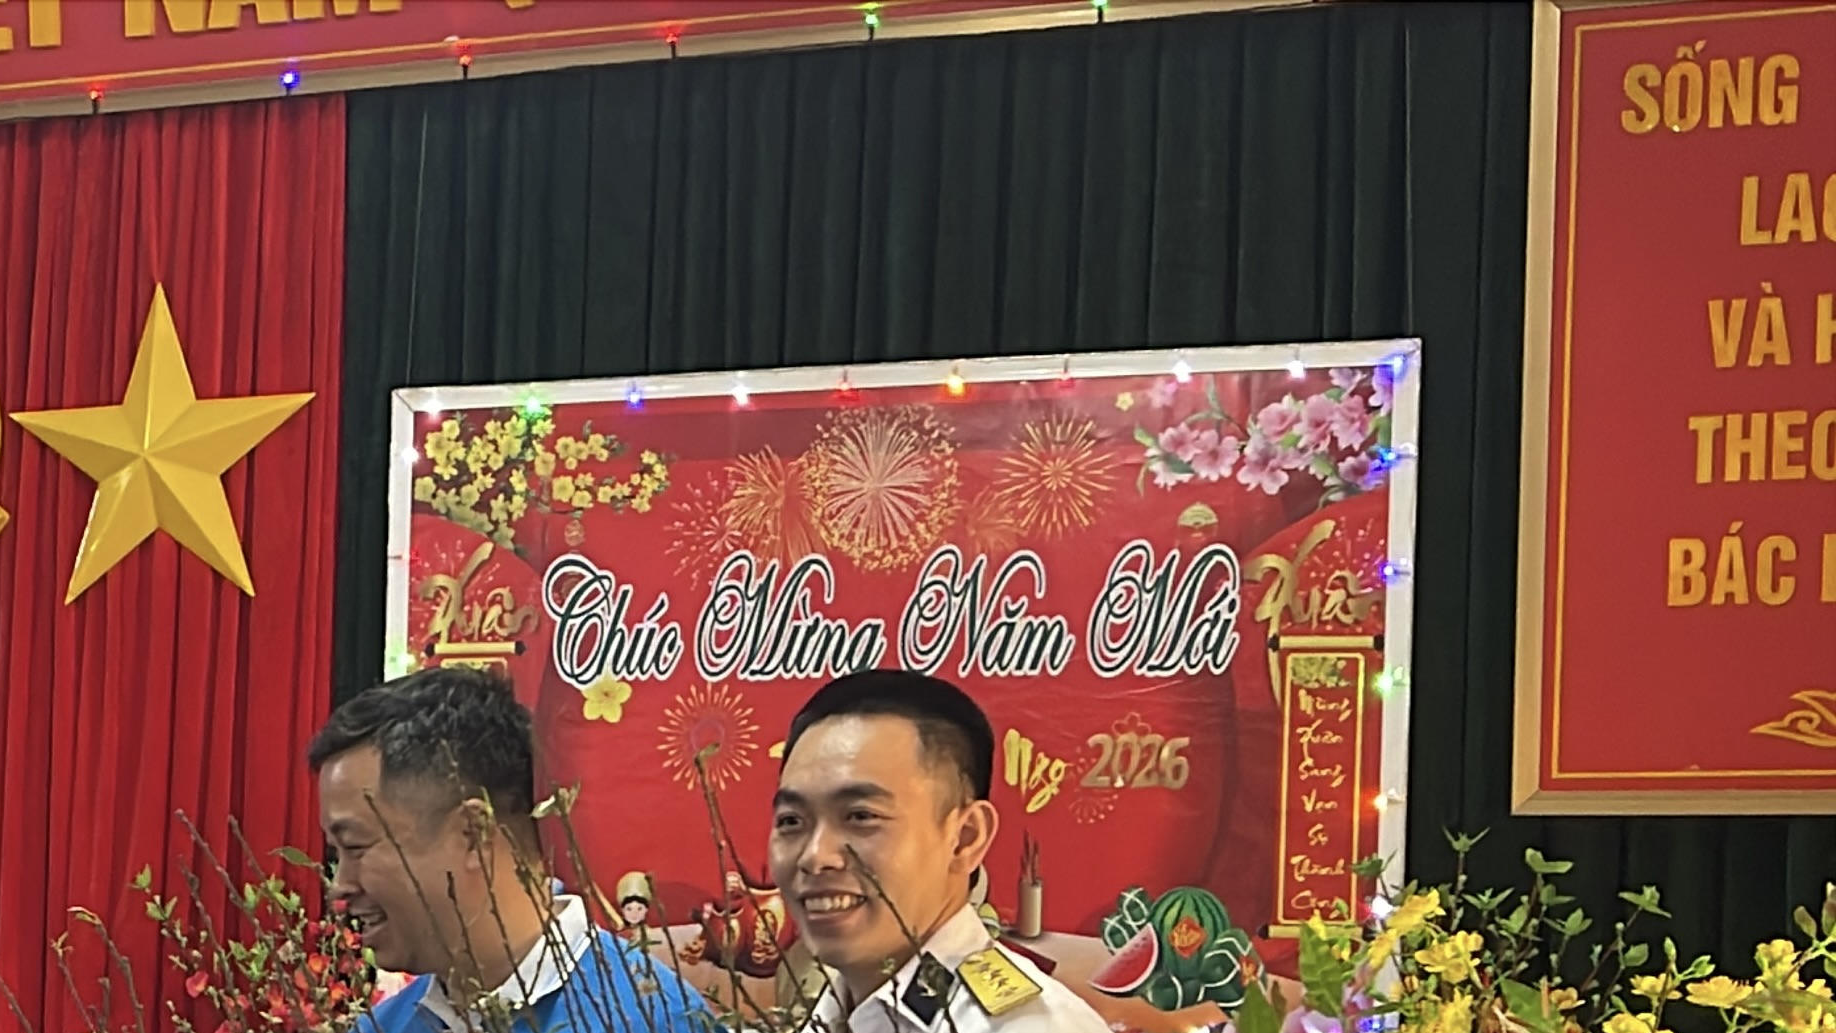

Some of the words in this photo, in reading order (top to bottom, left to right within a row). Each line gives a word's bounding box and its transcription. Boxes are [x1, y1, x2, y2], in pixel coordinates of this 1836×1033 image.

[1620, 40, 1801, 136] SỐNG
[1707, 282, 1792, 369] VÀ
[1666, 520, 1797, 609] BÁC
[544, 552, 682, 686] Chúc
[900, 543, 1073, 679] Năm
[1087, 537, 1243, 681] Mới
[1080, 732, 1191, 790] 2026
